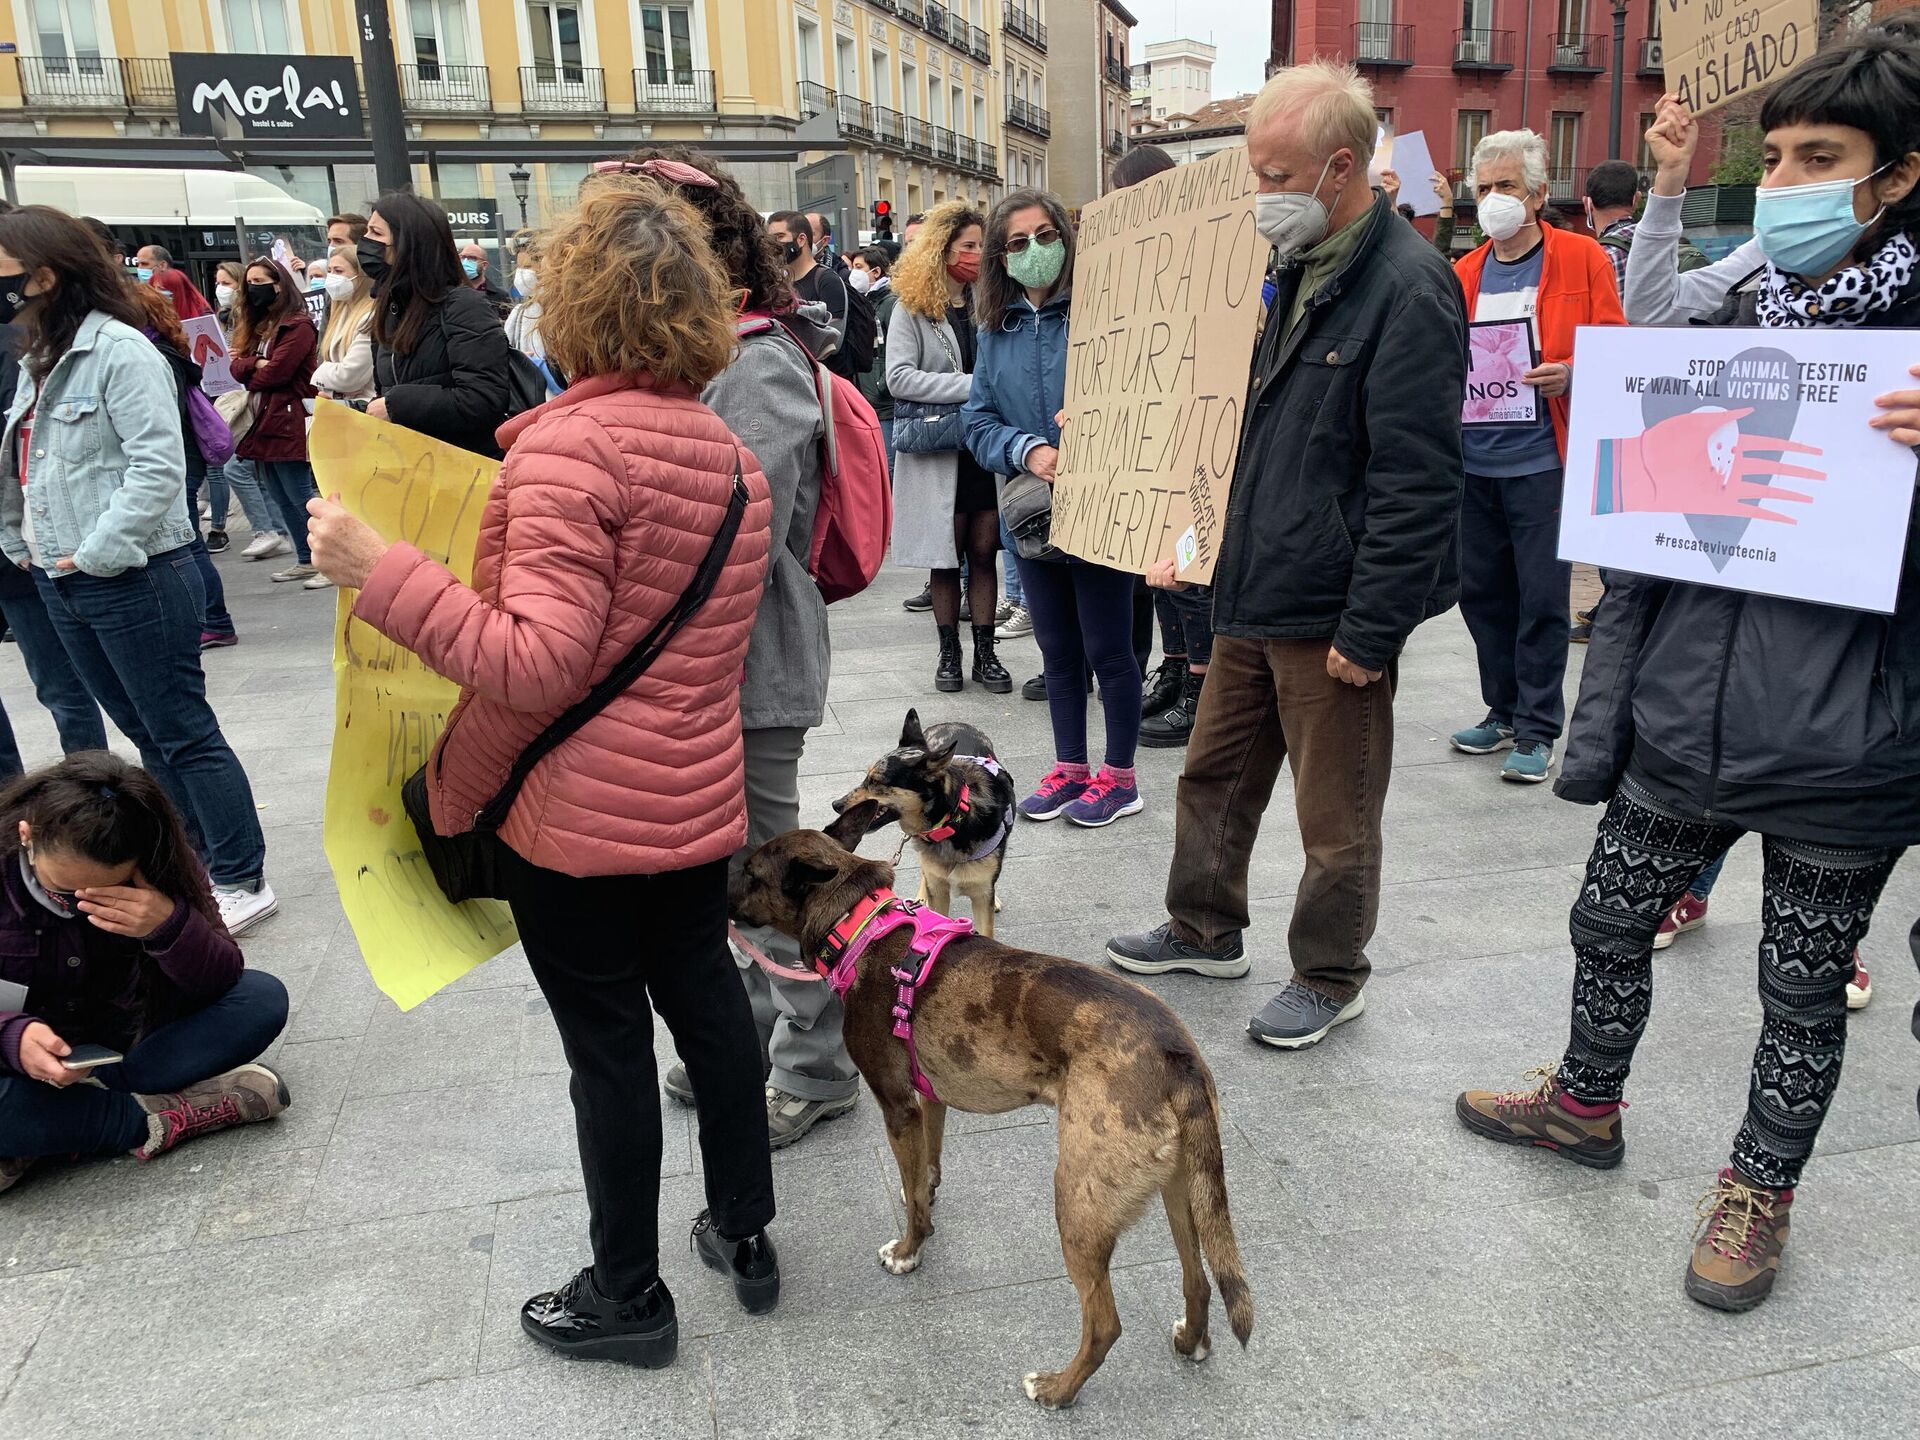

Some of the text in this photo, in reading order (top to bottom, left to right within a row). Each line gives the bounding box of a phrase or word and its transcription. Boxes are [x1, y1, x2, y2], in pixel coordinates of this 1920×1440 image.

[1678, 22, 1798, 114] AISLADO
[1696, 8, 1760, 60] UN CASO
[192, 64, 349, 120] Mola!
[1077, 151, 1260, 256] EXPERIMENTOS CON ANIMALE
[1075, 209, 1257, 333] MALTRATO
[1073, 314, 1197, 403] TORTURA
[1625, 376, 1840, 403] WE WANT ALL VICTIMS FREE
[1688, 359, 1868, 383] STOP ANIMAL TESTING
[1056, 395, 1238, 479] SUFRIMIENTO
[1102, 464, 1119, 503] Y
[1195, 463, 1217, 539] #RESCATE
[1067, 482, 1186, 569] MUERTE
[1655, 532, 1777, 562] #rescatevivotecnia
